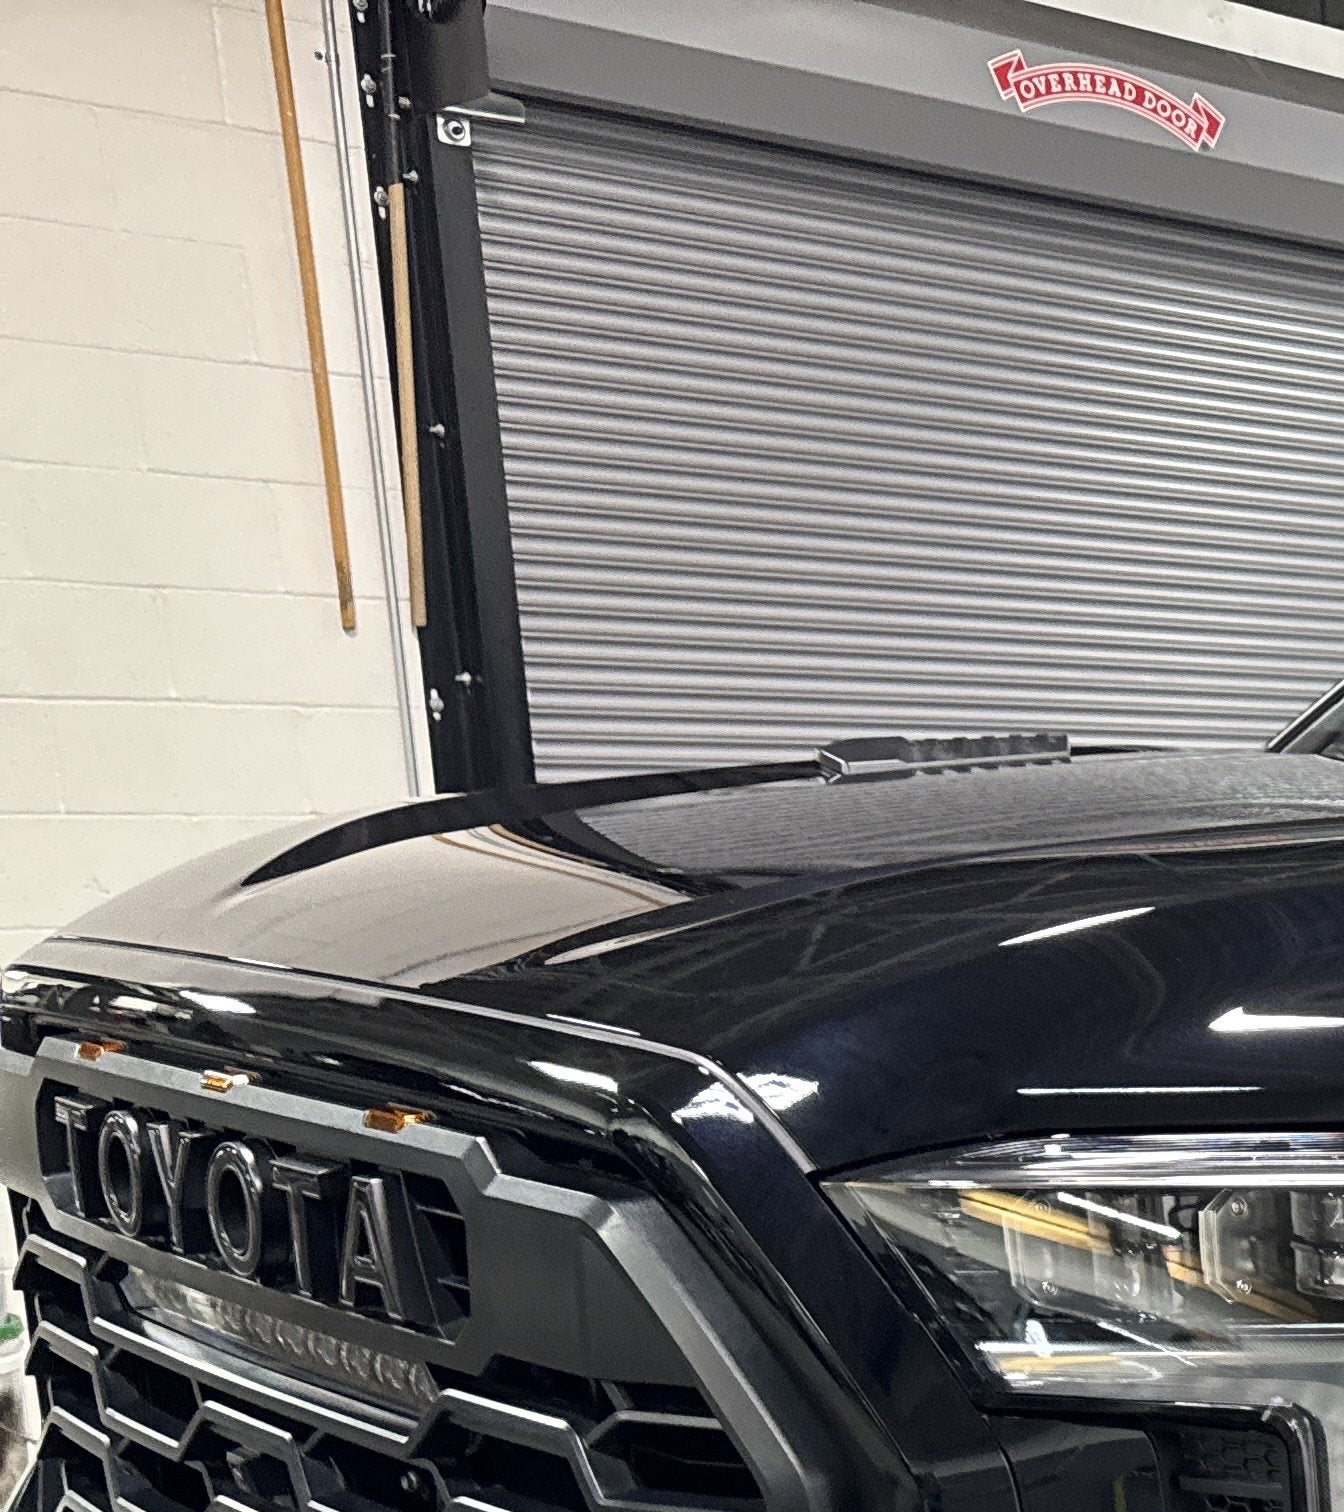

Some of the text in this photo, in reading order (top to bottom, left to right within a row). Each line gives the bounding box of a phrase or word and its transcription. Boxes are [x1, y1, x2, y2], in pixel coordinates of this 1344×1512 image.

[1019, 72, 1199, 139] OVERHEAD DOOR
[54, 1096, 407, 1321] TOYOTA
